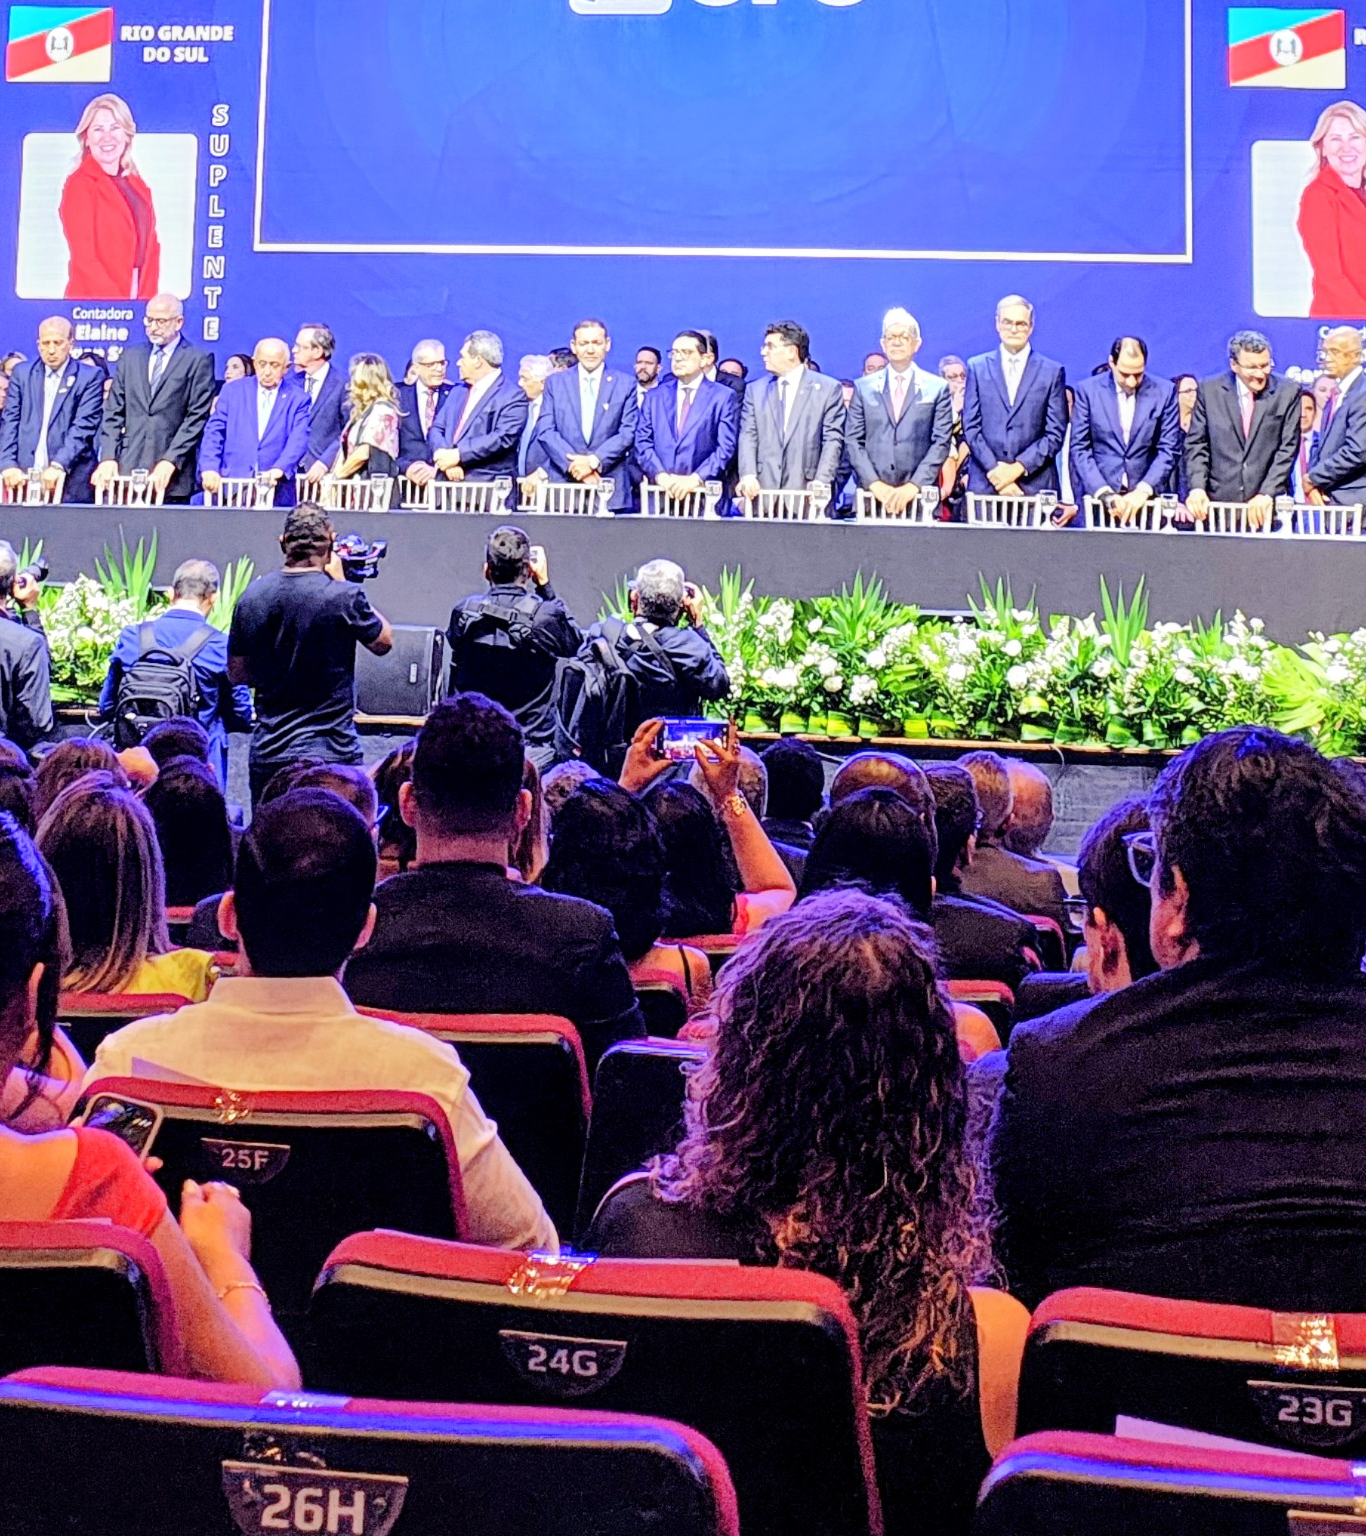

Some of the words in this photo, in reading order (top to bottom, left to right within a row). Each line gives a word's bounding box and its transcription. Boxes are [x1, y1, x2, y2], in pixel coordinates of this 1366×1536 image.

[120, 24, 155, 42] RIO
[157, 24, 235, 42] GRANDE
[143, 46, 171, 63] DO
[173, 46, 210, 63] SUL
[203, 103, 231, 342] SUPLENTE
[72, 306, 134, 321] Contadora
[75, 323, 130, 341] Elaine
[221, 1147, 270, 1171] 25F
[527, 1344, 599, 1377] 24G
[1277, 1394, 1353, 1427] 23G
[260, 1483, 366, 1536] 26H
